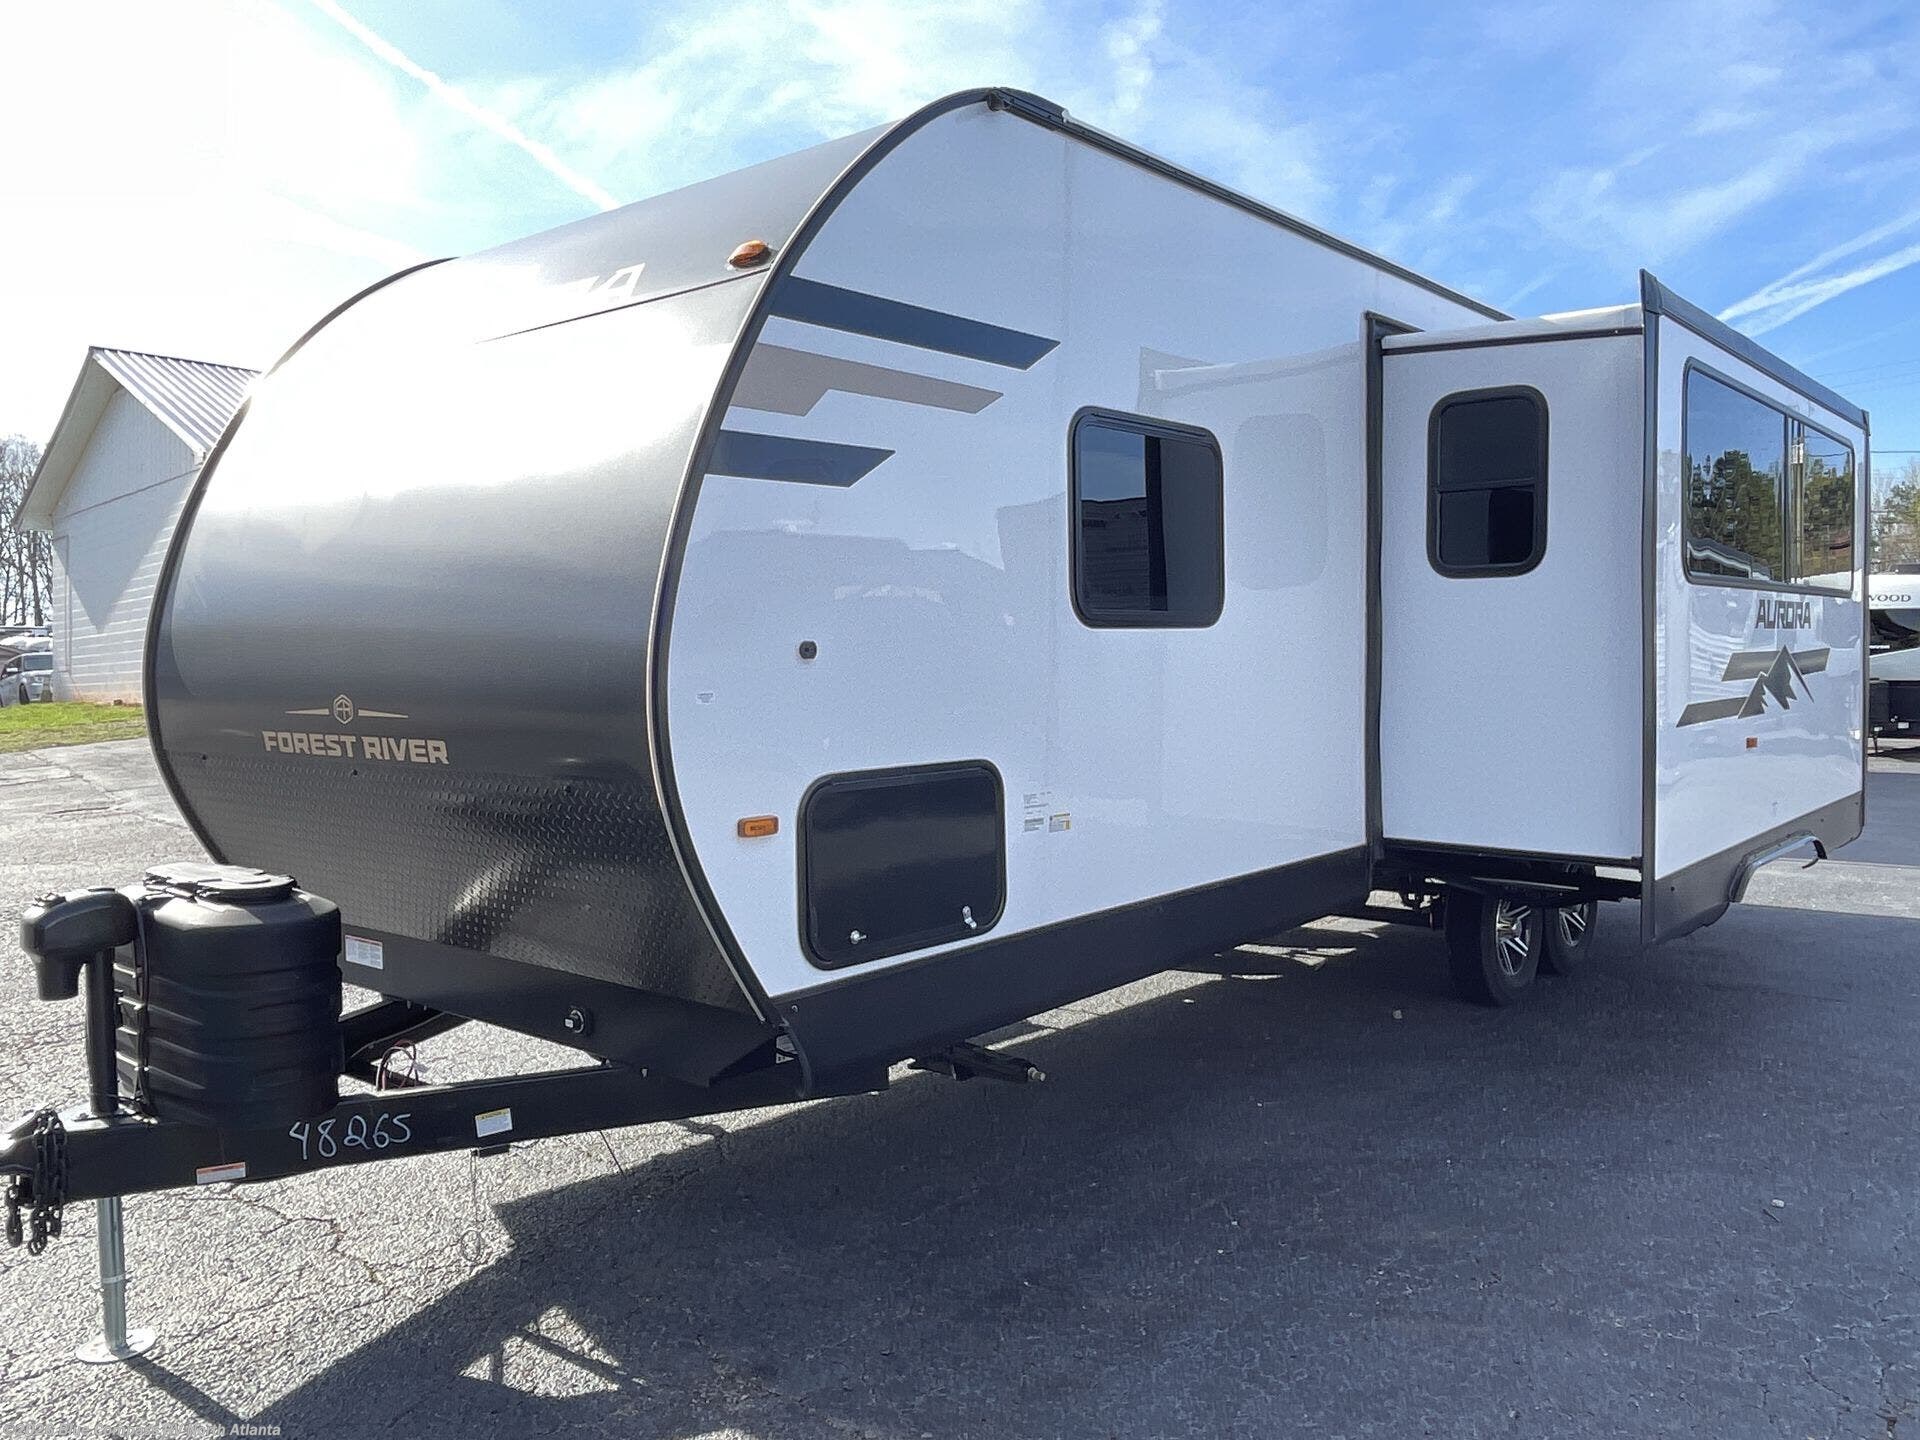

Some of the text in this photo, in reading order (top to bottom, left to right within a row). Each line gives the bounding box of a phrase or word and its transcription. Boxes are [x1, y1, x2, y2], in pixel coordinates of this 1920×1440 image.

[1755, 599, 1811, 629] AURORA
[262, 731, 449, 764] FOREST RIVER
[288, 1113, 412, 1160] 48265
